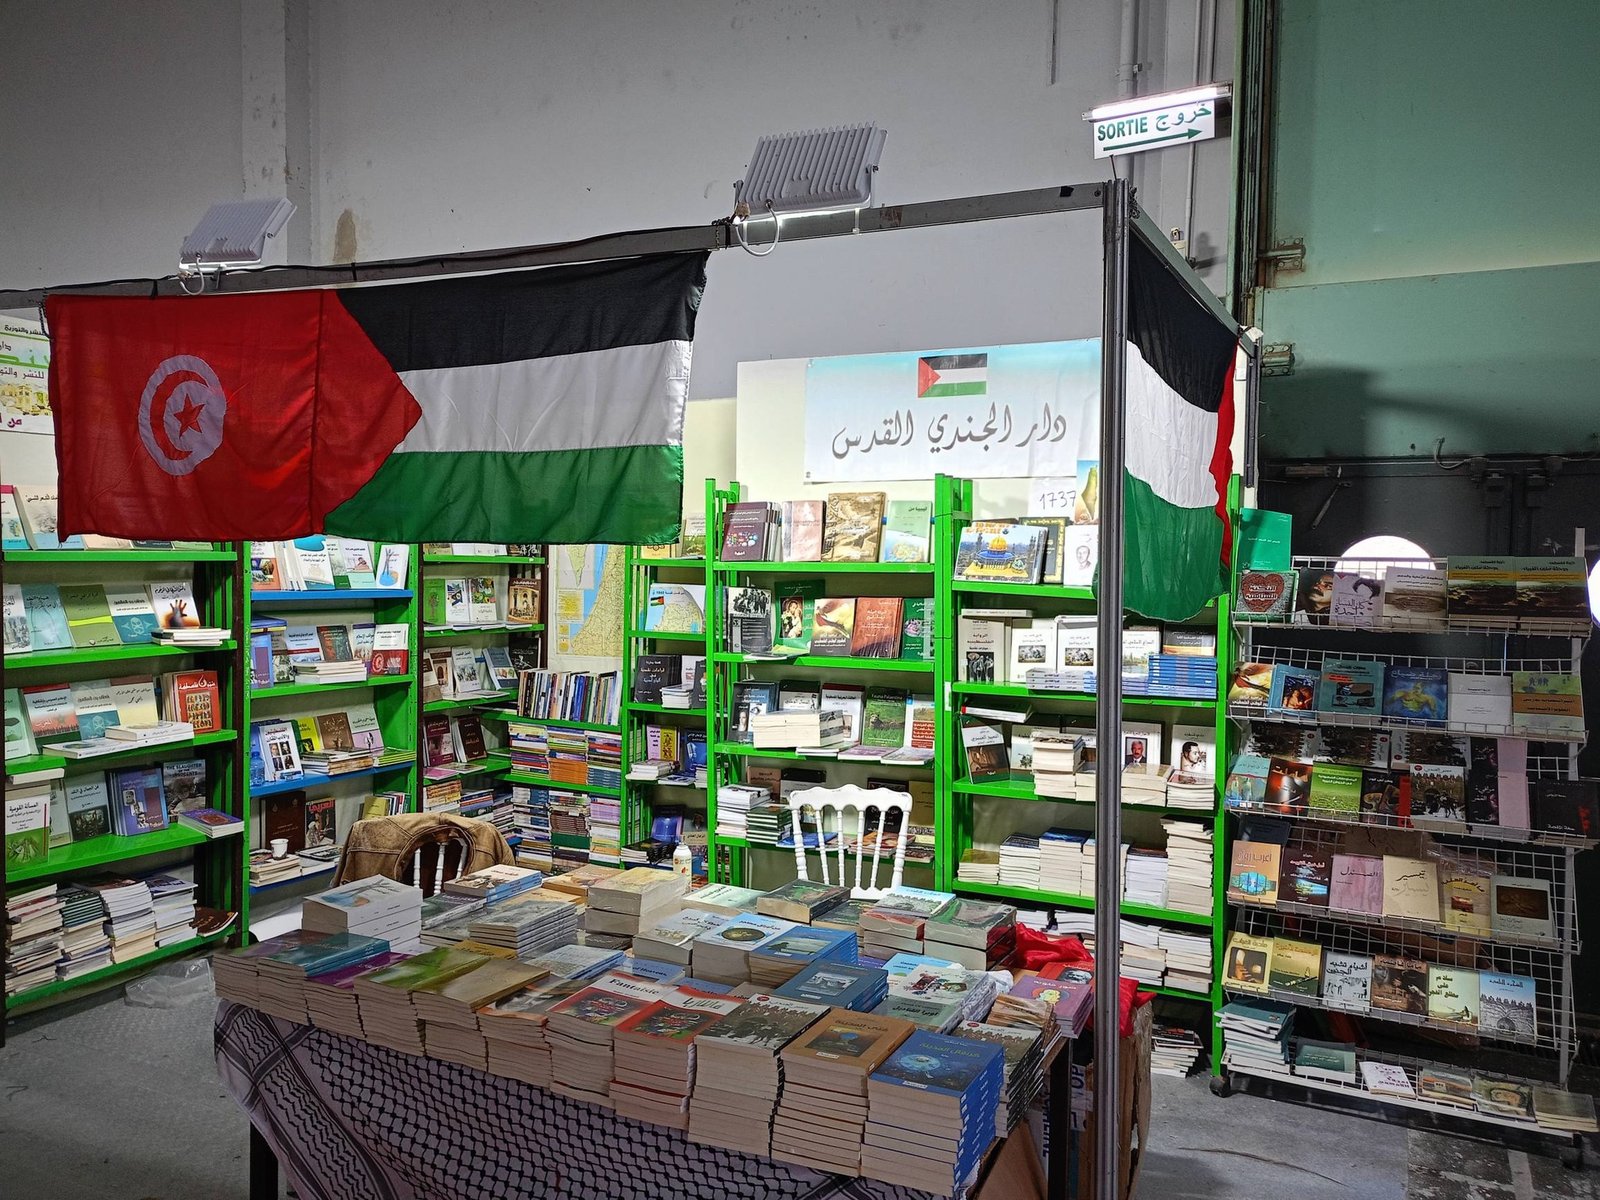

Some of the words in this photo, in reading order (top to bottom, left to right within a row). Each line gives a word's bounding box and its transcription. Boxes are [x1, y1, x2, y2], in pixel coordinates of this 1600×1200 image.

[1097, 116, 1148, 141] SORTIE
[1155, 103, 1212, 131] خروج
[23, 369, 44, 379] للنشر
[832, 408, 914, 460] القدس
[928, 401, 1013, 454] الجندي
[1015, 402, 1067, 448] دار
[1039, 490, 1077, 510] 1737
[1349, 961, 1367, 971] أشياء
[609, 978, 660, 995] Fantaisie
